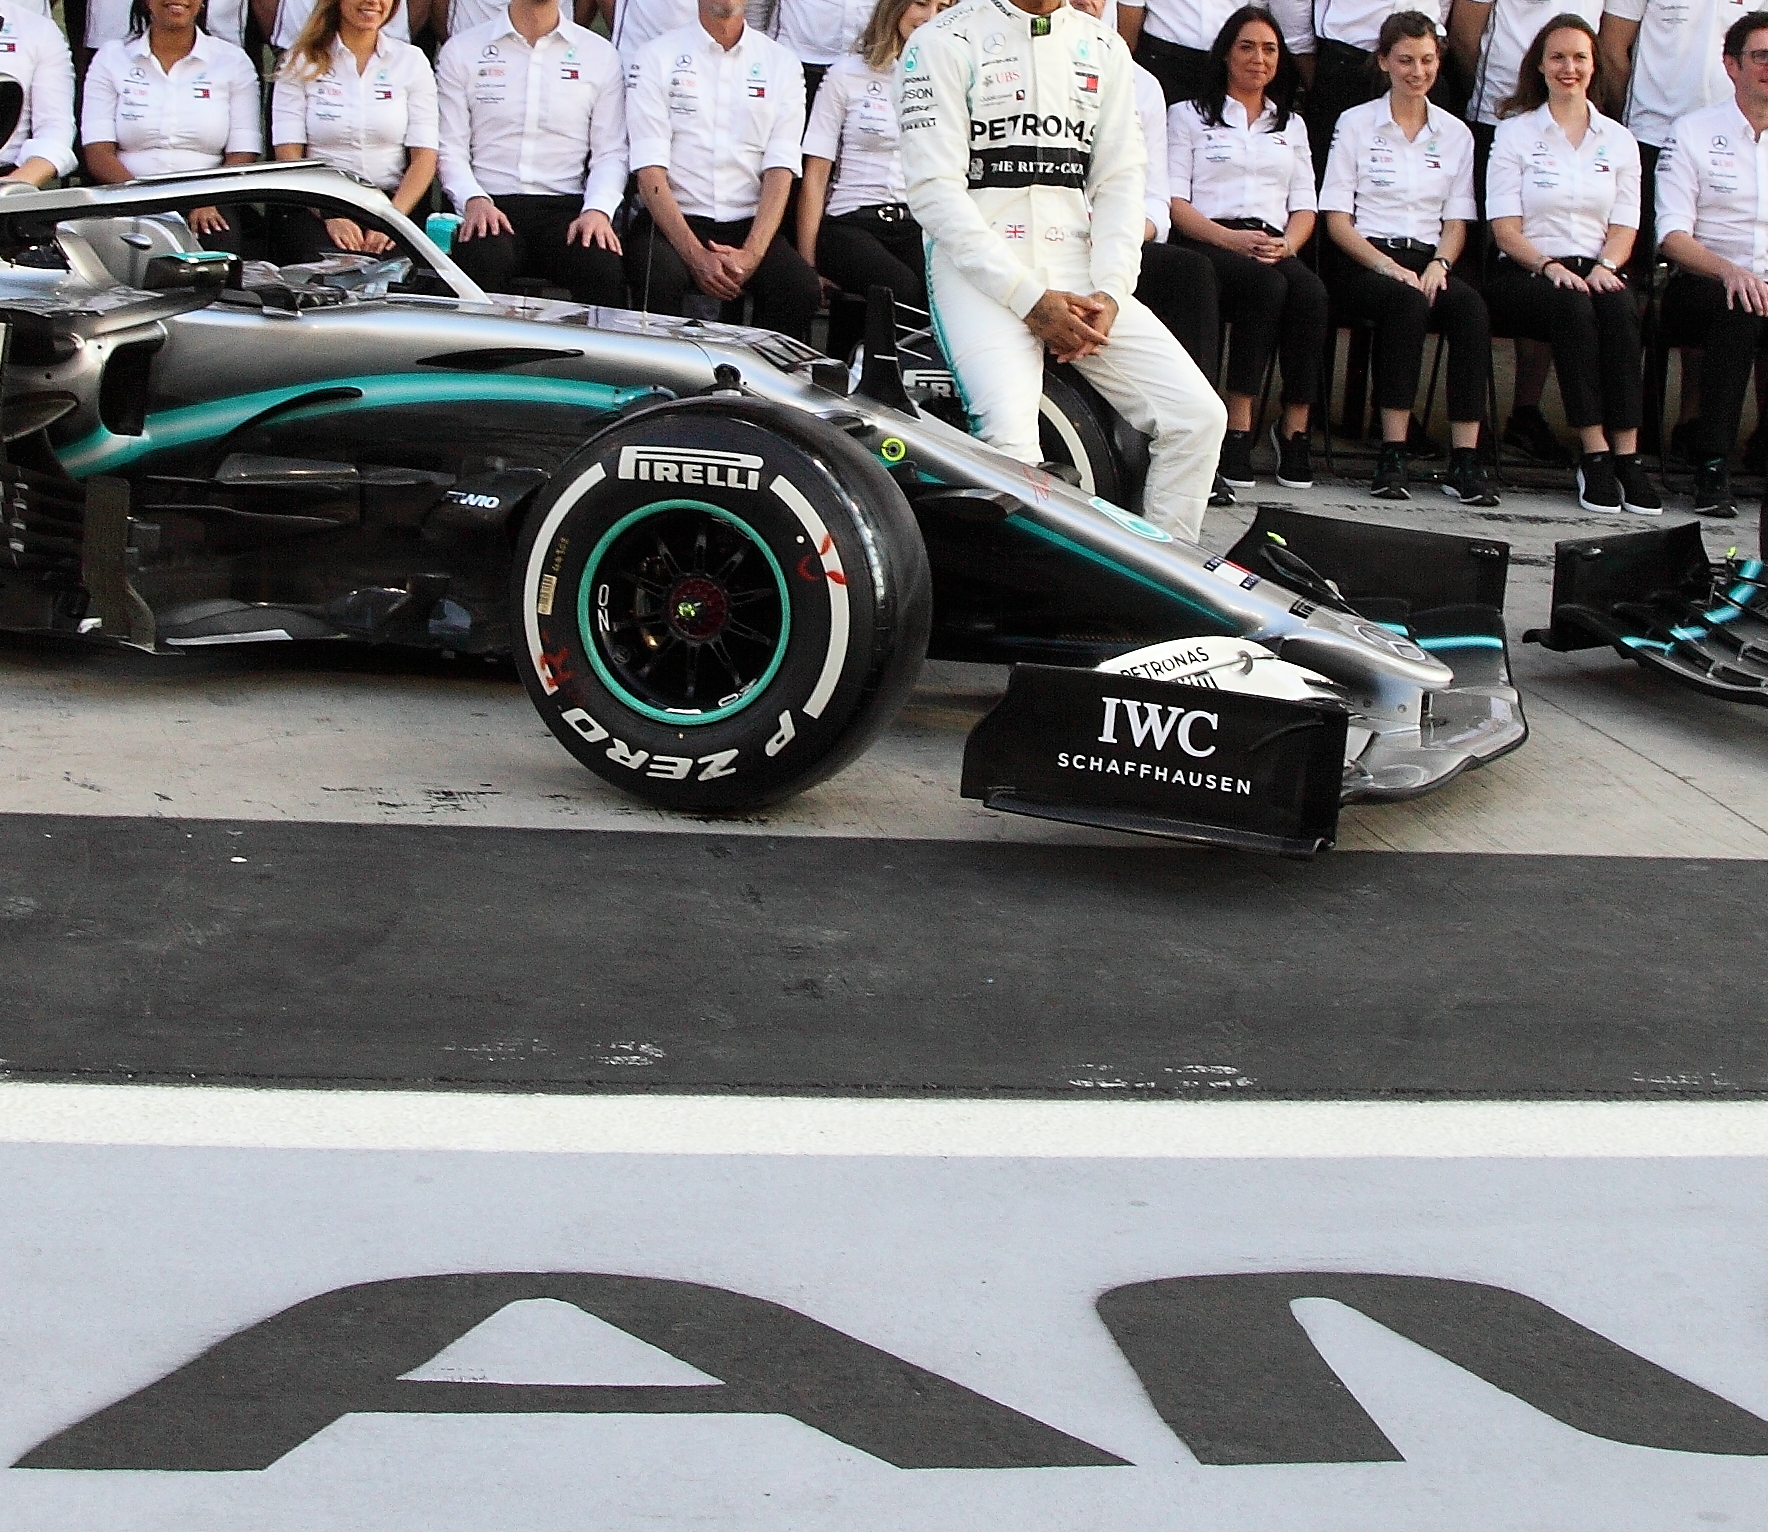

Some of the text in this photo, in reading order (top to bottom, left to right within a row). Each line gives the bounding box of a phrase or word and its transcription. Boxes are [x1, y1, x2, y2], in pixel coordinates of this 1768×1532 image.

[900, 87, 934, 104] SON
[995, 70, 1020, 84] UBS
[617, 444, 764, 491] PIRELLI
[560, 706, 740, 782] ZERO
[1097, 695, 1220, 758] IWC
[1056, 751, 1252, 796] SCHAFFHAUSEN
